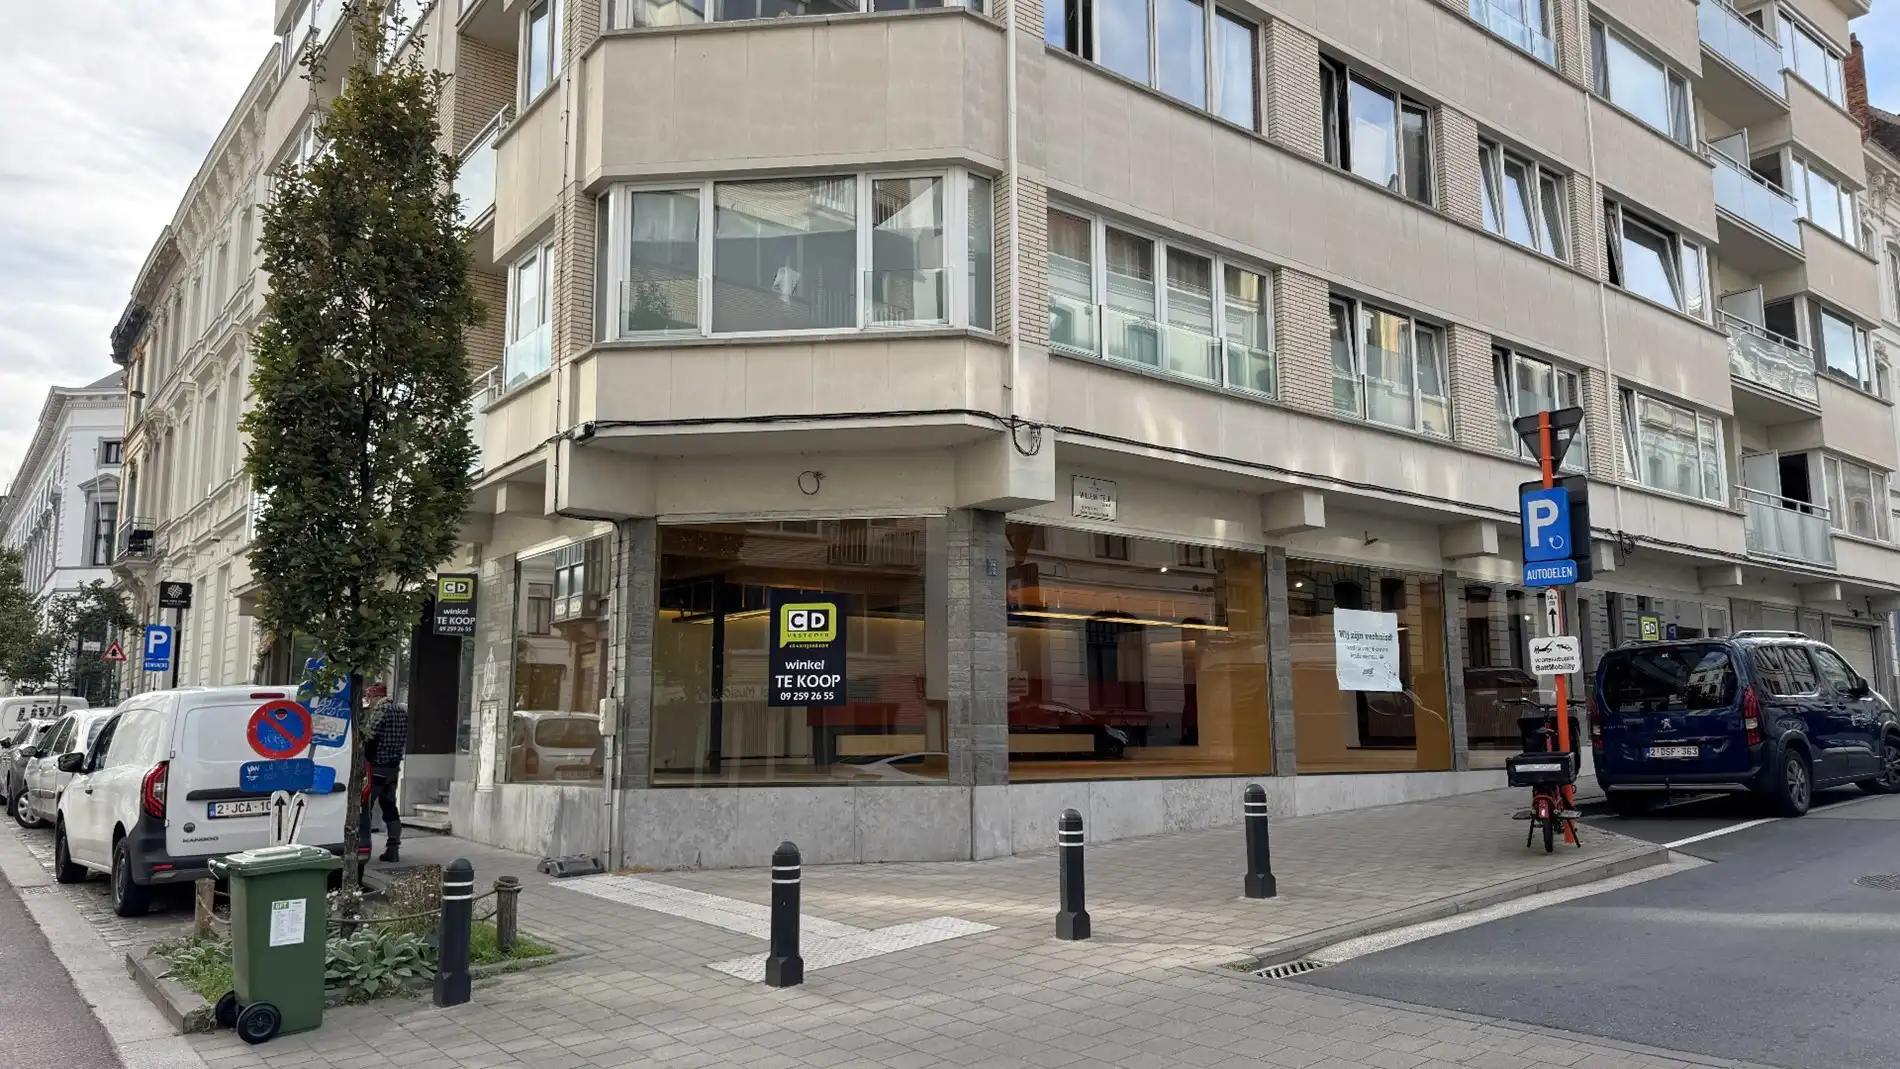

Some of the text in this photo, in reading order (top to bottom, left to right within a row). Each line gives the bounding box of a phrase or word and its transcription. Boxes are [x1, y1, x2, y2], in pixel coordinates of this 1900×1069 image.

[1527, 498, 1559, 548] P
[1527, 566, 1573, 581] AUTODELEN
[445, 582, 467, 593] CD
[437, 616, 476, 625] TE KOOP
[790, 612, 826, 629] CD
[148, 630, 168, 654] P
[785, 660, 825, 670] winkel
[775, 674, 841, 688] TE KOOP
[780, 692, 835, 701] 09 259 26 55
[182, 836, 219, 844] KANGOO
